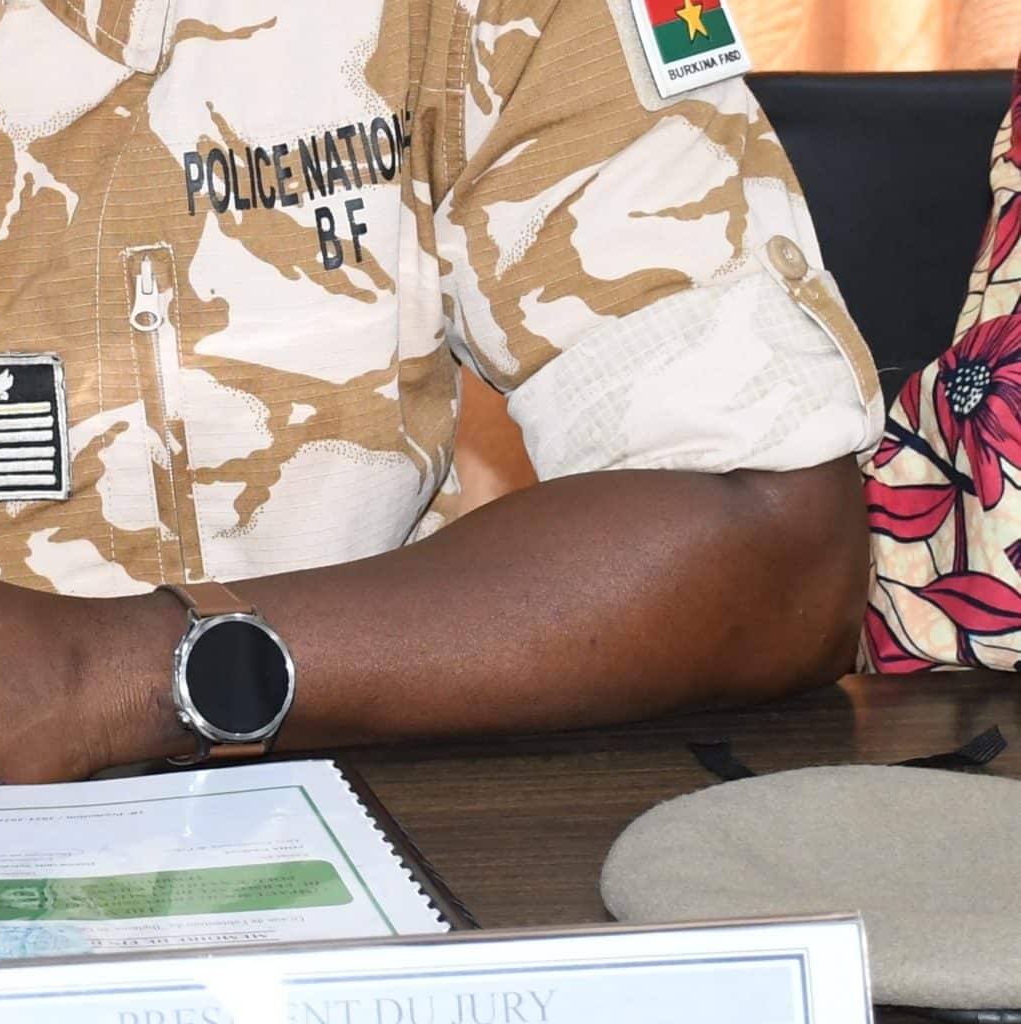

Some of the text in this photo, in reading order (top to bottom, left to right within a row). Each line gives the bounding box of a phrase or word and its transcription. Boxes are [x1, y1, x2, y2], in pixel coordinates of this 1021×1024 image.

[667, 49, 742, 81] BURKINA FASO
[183, 109, 412, 216] POLICE NATION
[374, 995, 435, 1024] DU
[451, 991, 557, 1024] JURY
